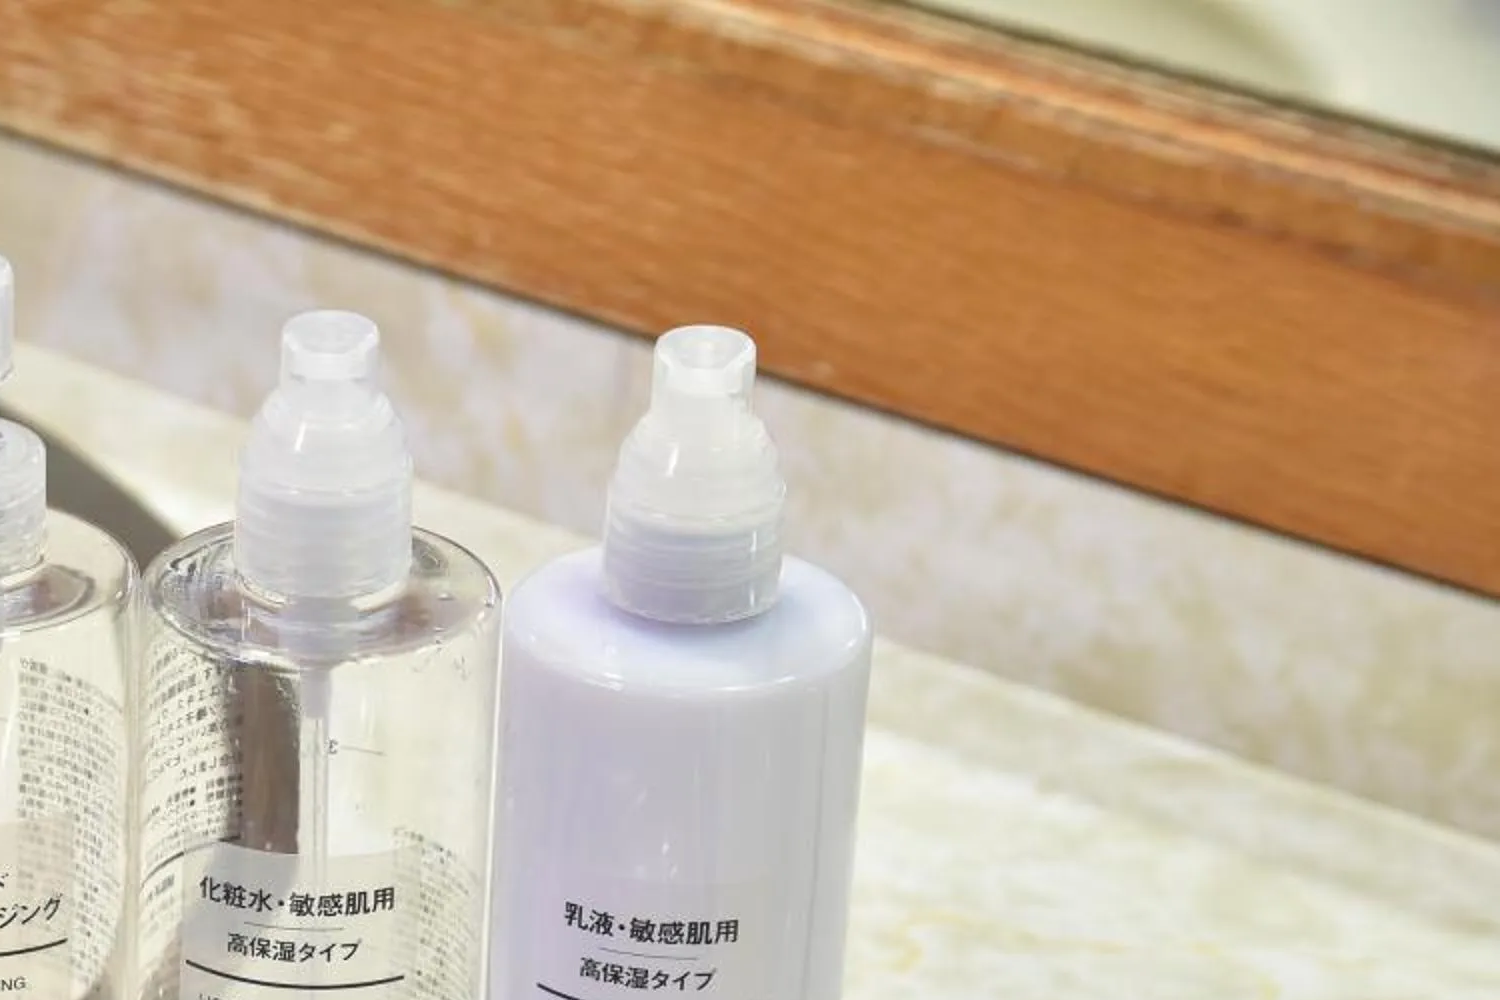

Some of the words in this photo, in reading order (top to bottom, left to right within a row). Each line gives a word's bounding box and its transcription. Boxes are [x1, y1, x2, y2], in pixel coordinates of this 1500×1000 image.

[199, 875, 396, 918] 化粧水・敏感肌用
[563, 900, 740, 946] 乳液・敏感肌用
[227, 932, 363, 964] 高保湿タイプ
[579, 956, 717, 992] 高保湿タイプ
